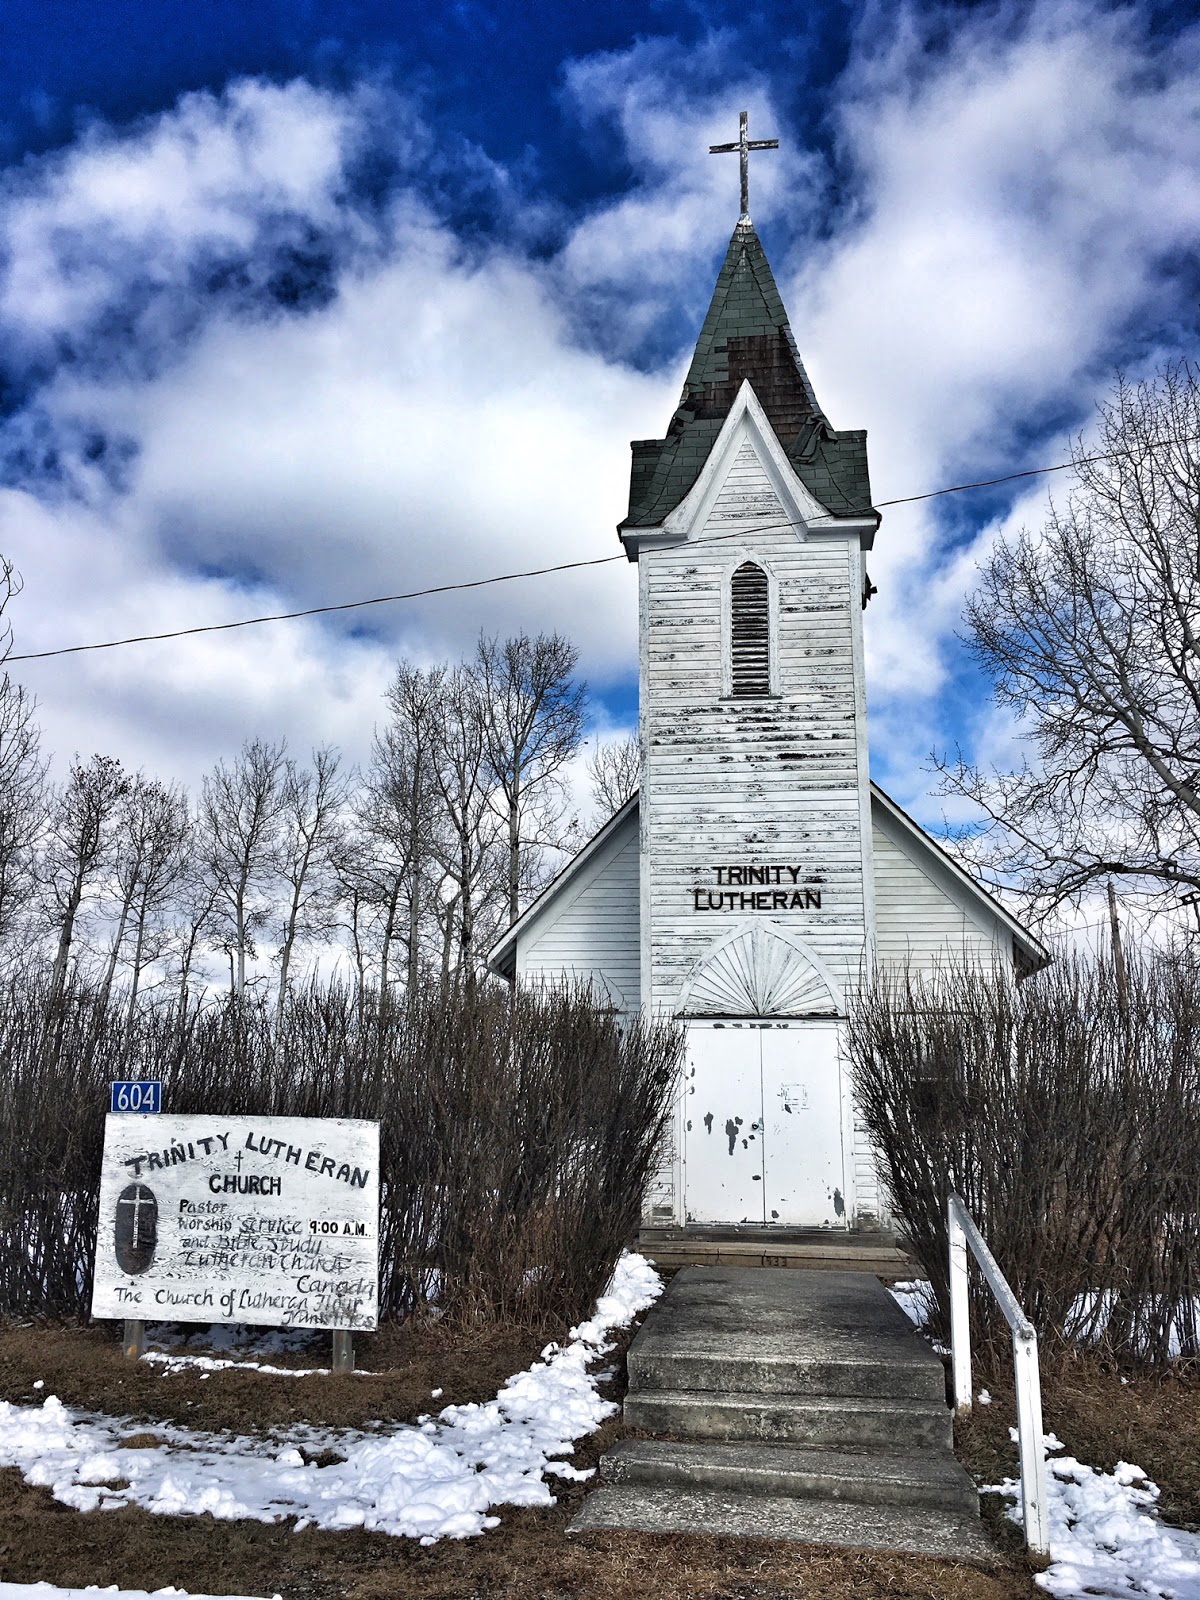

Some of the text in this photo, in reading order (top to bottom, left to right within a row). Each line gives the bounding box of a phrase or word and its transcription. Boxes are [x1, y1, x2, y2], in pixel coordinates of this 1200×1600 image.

[711, 865, 801, 885] TRINITY
[694, 891, 822, 910] LUTHERAN
[117, 1084, 155, 1111] 604
[125, 1132, 370, 1188] TRINITY LUTHERAN
[208, 1174, 282, 1196] CHURCH
[309, 1220, 339, 1234] 9:00
[114, 1287, 143, 1304] The
[154, 1288, 214, 1306] Church
[220, 1289, 236, 1317] of
[237, 1288, 308, 1310] Lutheran
